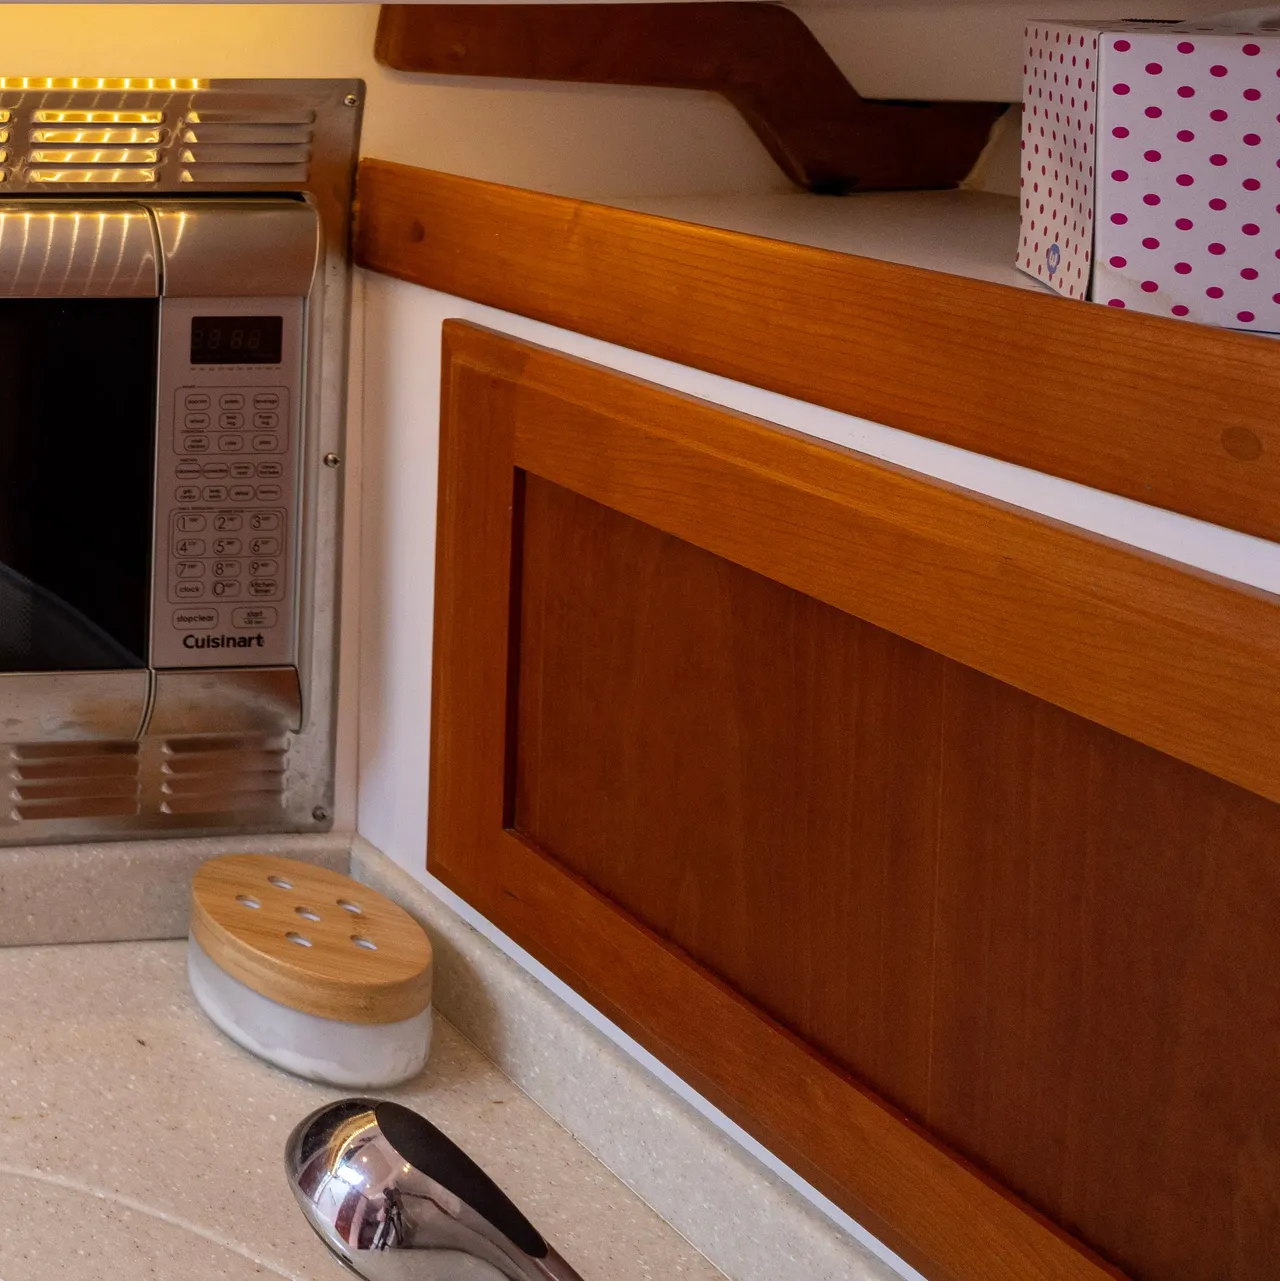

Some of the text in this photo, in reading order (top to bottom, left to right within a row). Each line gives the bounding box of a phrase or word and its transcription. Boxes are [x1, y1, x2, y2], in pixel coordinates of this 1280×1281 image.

[252, 516, 261, 529] 3
[179, 541, 188, 553] 4
[216, 541, 225, 553] 5
[252, 540, 260, 552] 6
[215, 562, 224, 575] 8
[182, 633, 265, 649] Cuisinart
